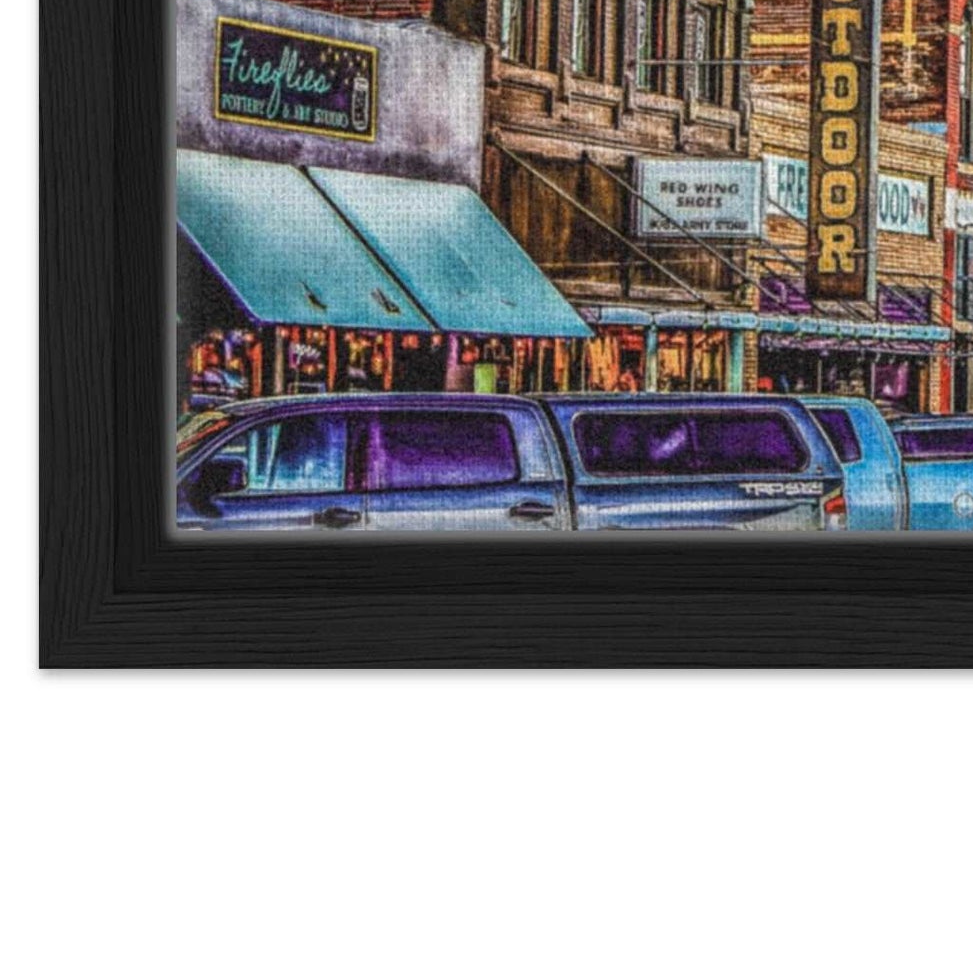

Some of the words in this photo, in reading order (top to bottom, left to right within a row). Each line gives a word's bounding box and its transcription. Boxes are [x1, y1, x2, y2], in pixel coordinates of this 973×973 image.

[222, 37, 331, 119] Fireflies
[659, 181, 688, 194] RED
[693, 182, 740, 194] WING
[676, 196, 723, 208] SHOES
[879, 181, 910, 225] OOD
